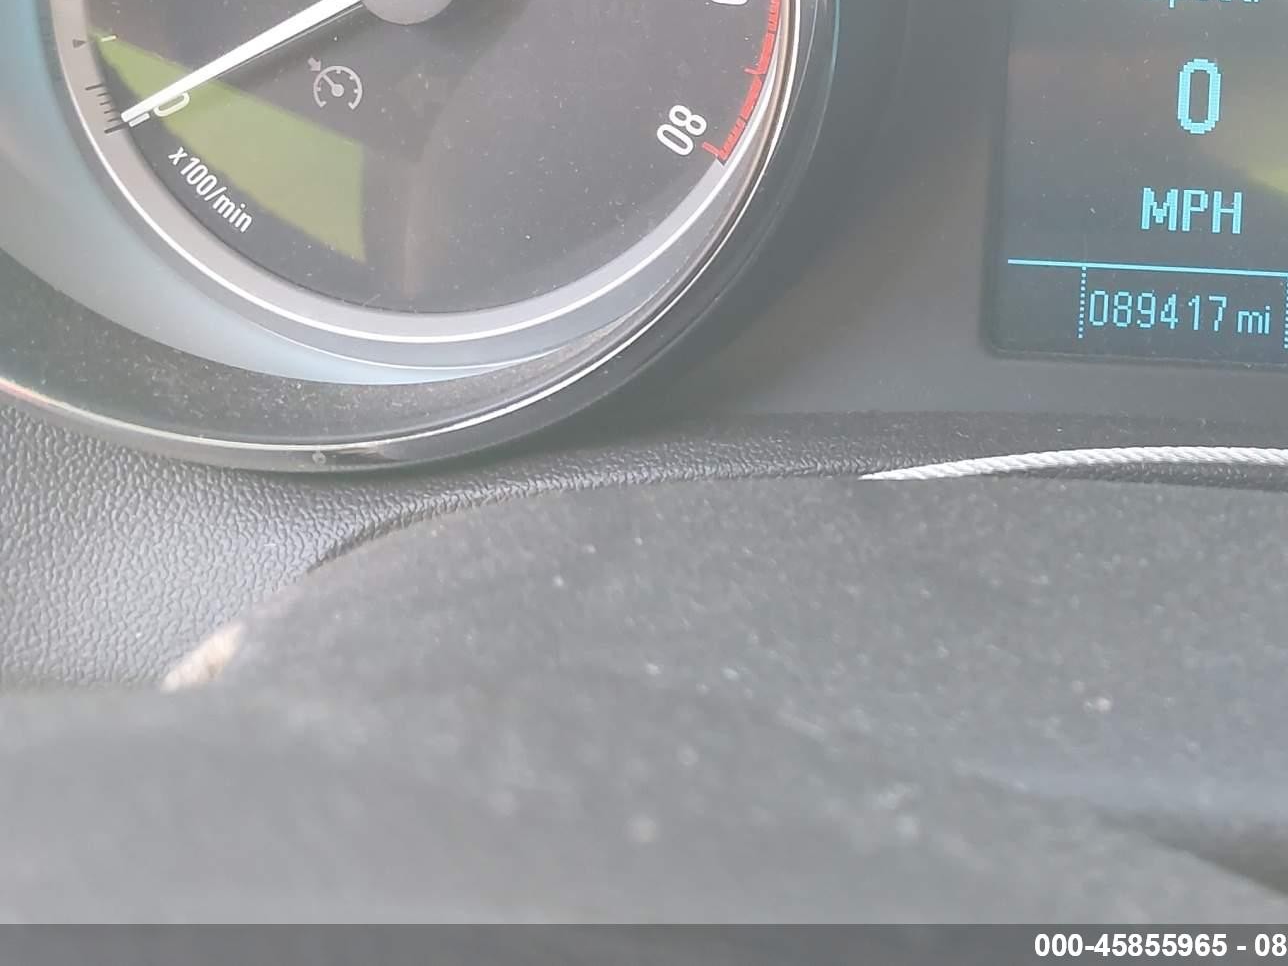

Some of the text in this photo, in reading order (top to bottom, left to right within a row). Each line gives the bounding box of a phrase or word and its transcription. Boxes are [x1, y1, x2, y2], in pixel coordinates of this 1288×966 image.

[1177, 58, 1222, 134] 0
[656, 104, 707, 156] 80
[1141, 187, 1243, 234] MPH
[1089, 290, 1271, 335] 089417 mi
